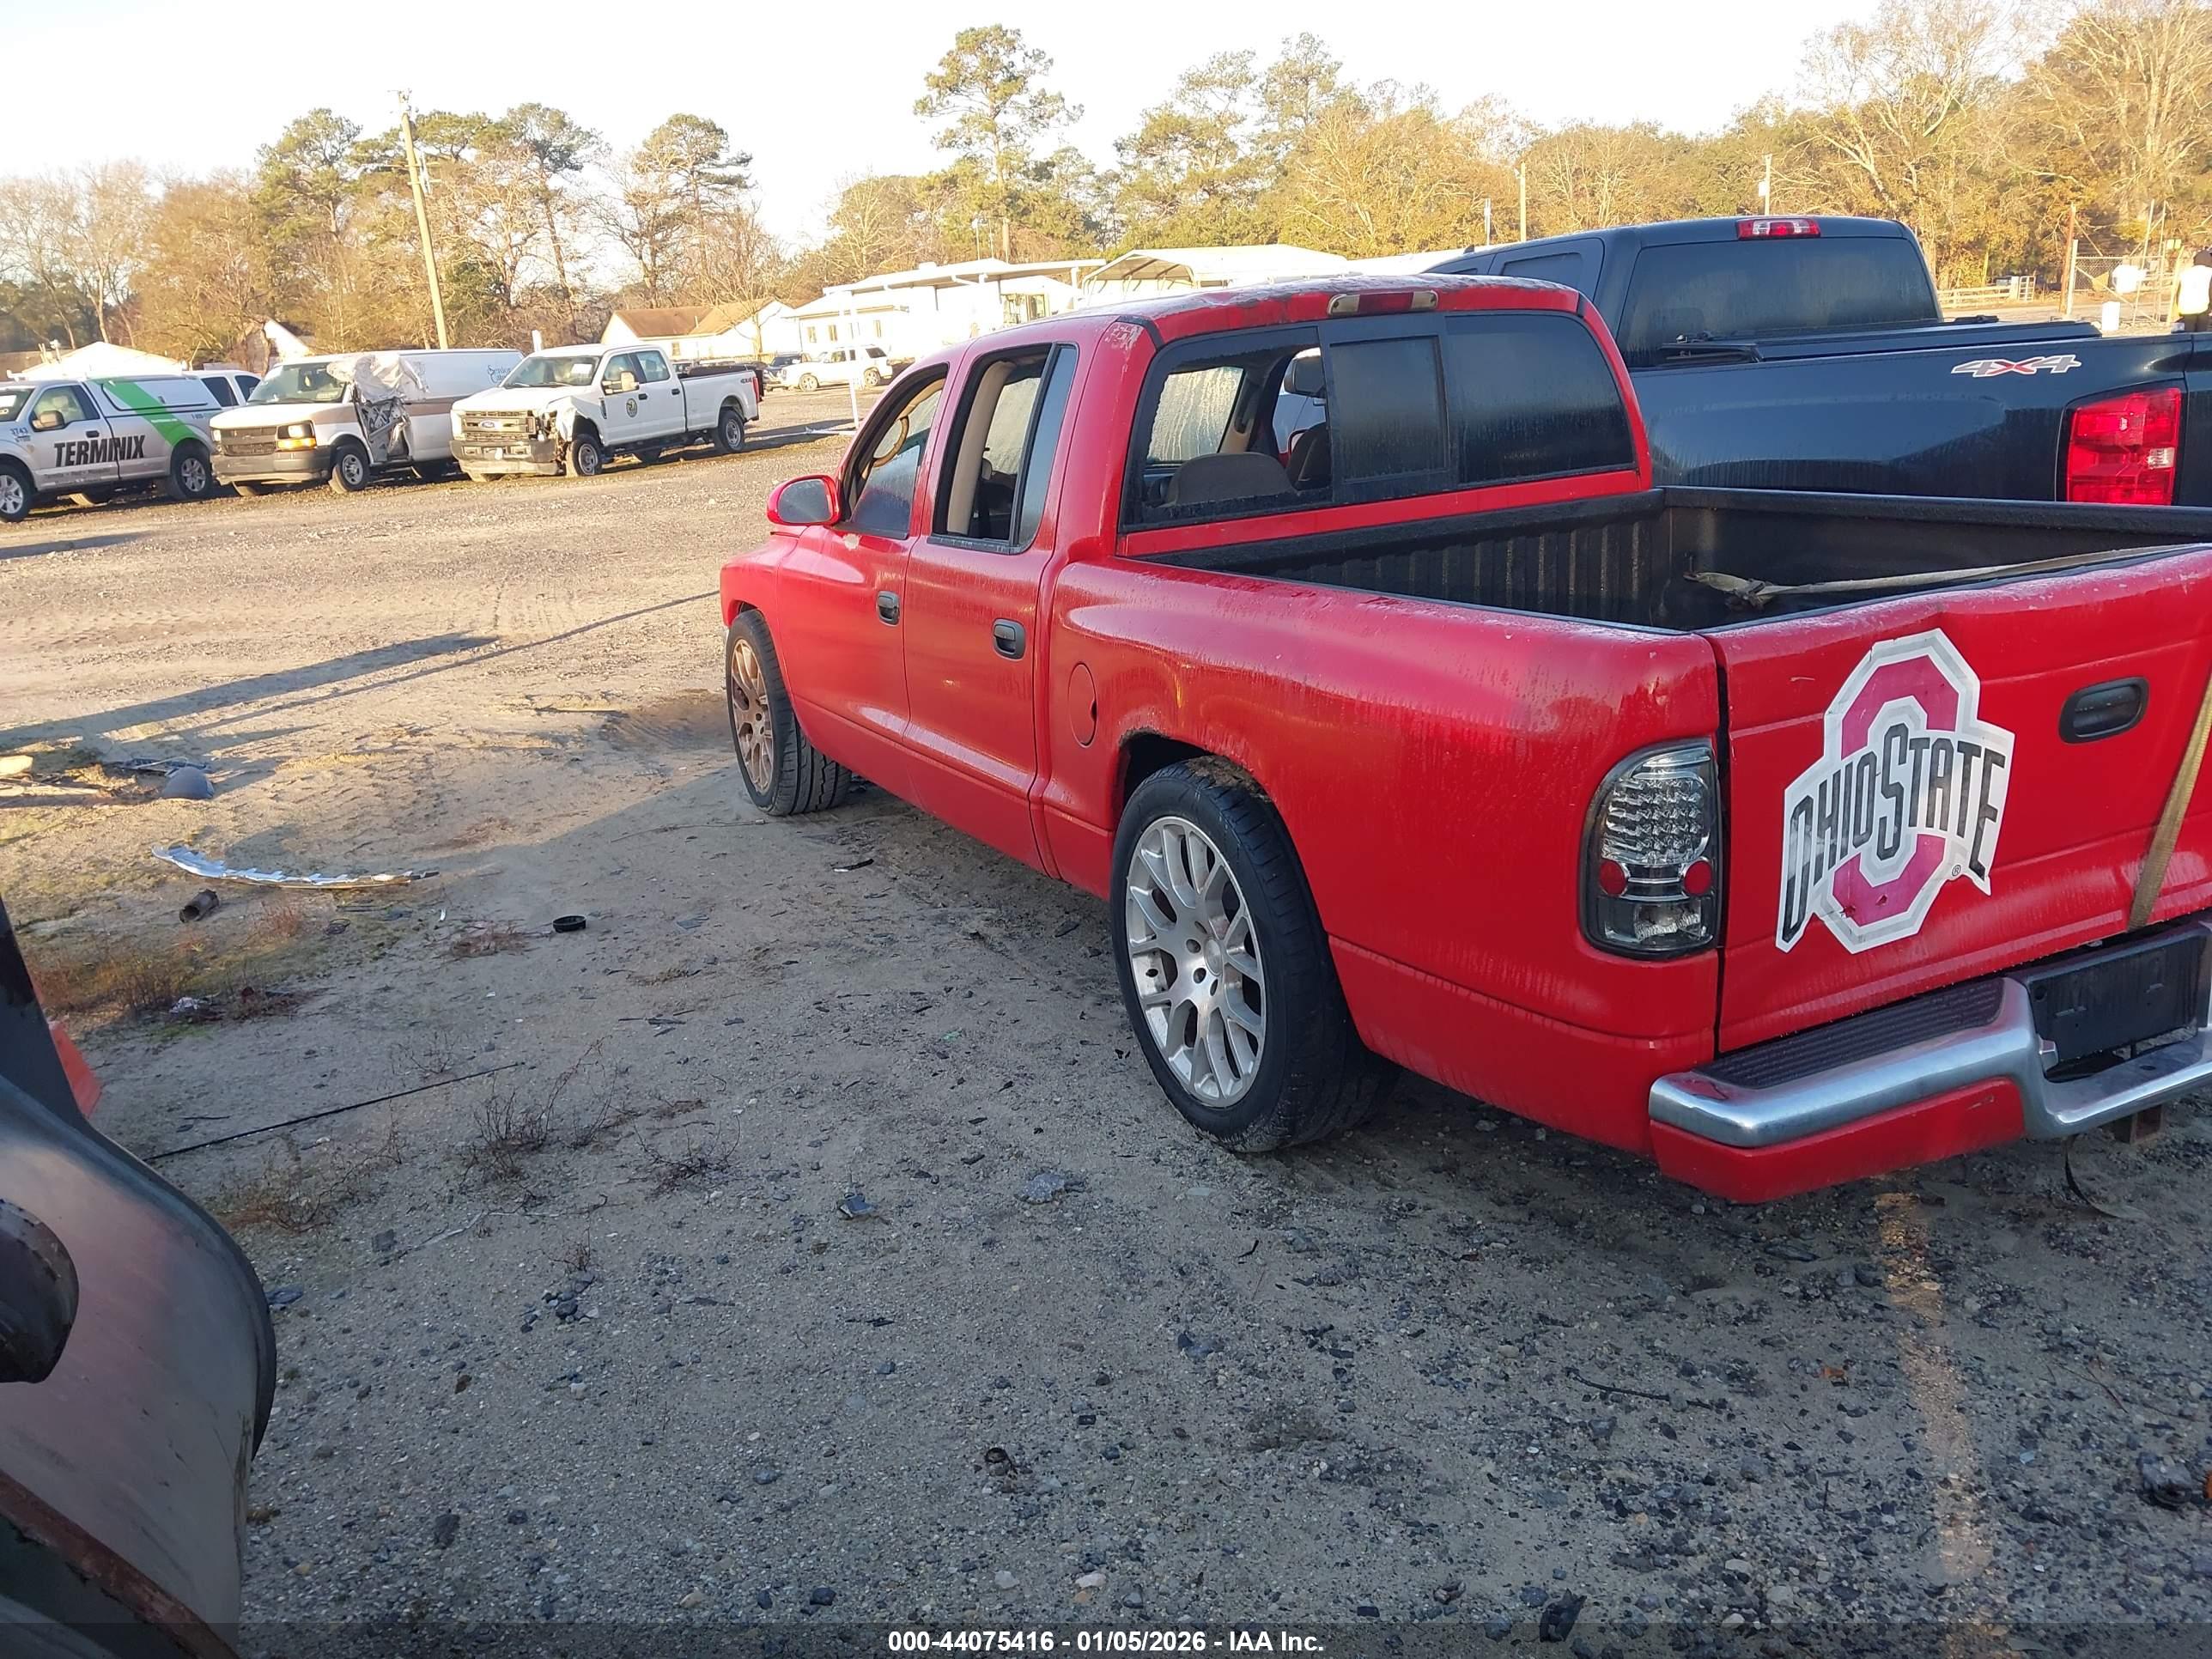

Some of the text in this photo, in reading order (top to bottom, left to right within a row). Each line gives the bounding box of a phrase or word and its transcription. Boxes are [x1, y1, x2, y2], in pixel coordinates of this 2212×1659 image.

[53, 434, 146, 468] TERMINIX
[1781, 723, 2008, 944] OHIO STATE
